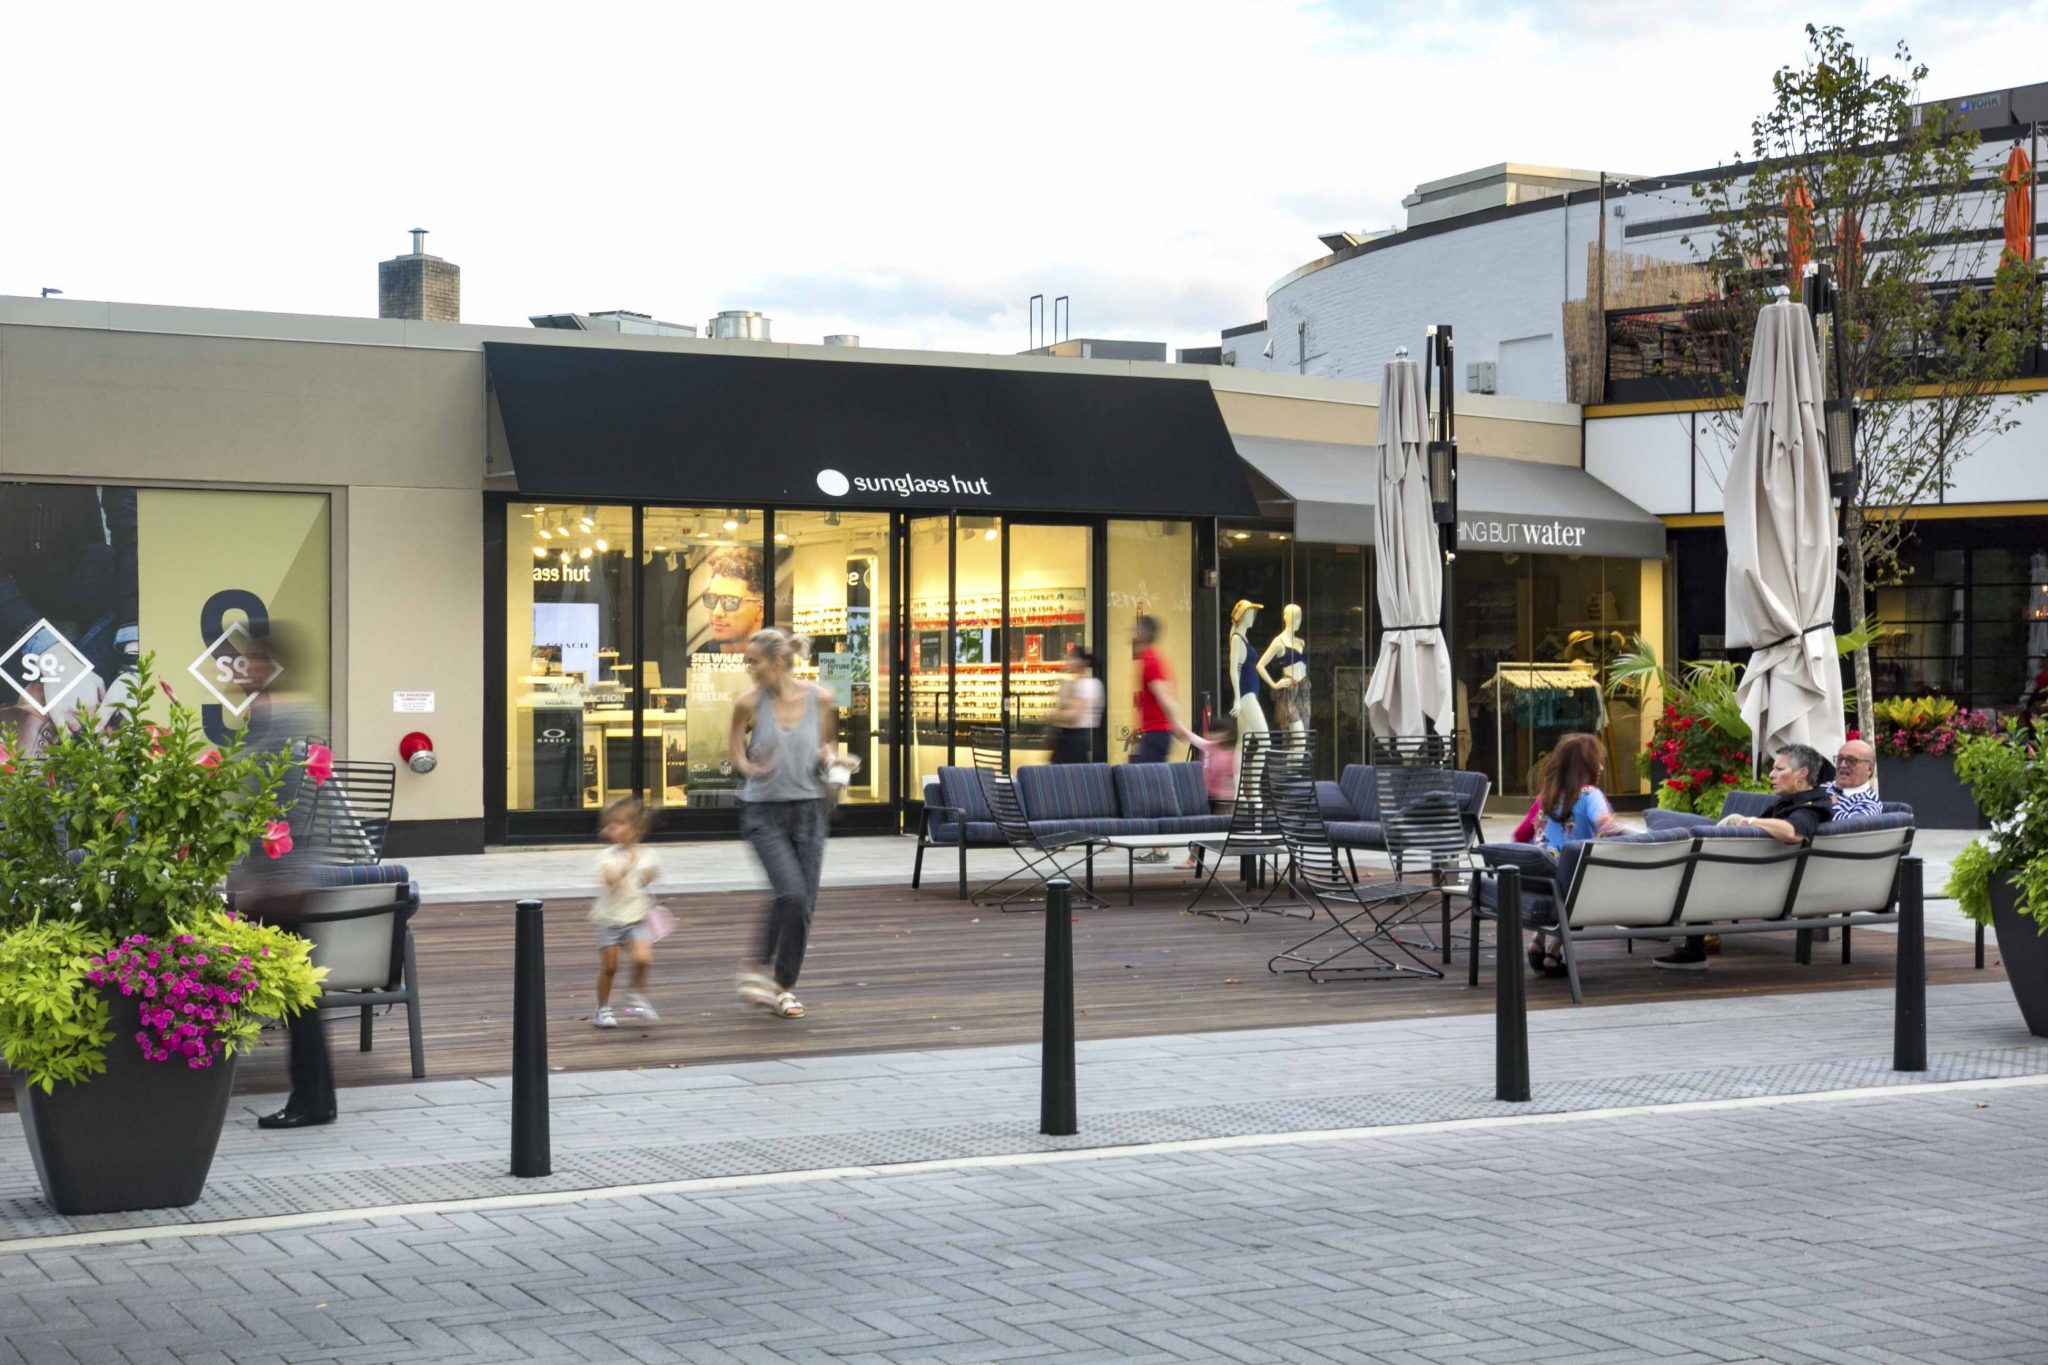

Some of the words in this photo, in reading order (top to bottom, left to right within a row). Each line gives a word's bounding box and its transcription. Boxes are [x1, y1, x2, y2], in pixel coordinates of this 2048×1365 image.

[1971, 96, 1999, 109] YORK
[854, 473, 950, 497] sunglass
[951, 474, 992, 495] hut
[1457, 520, 1488, 542] ING
[1490, 522, 1519, 543] BUT
[1522, 521, 1585, 546] water
[562, 563, 591, 582] hut
[691, 653, 711, 662] SEE
[711, 653, 745, 663] WHAT
[691, 663, 719, 672] THEY
